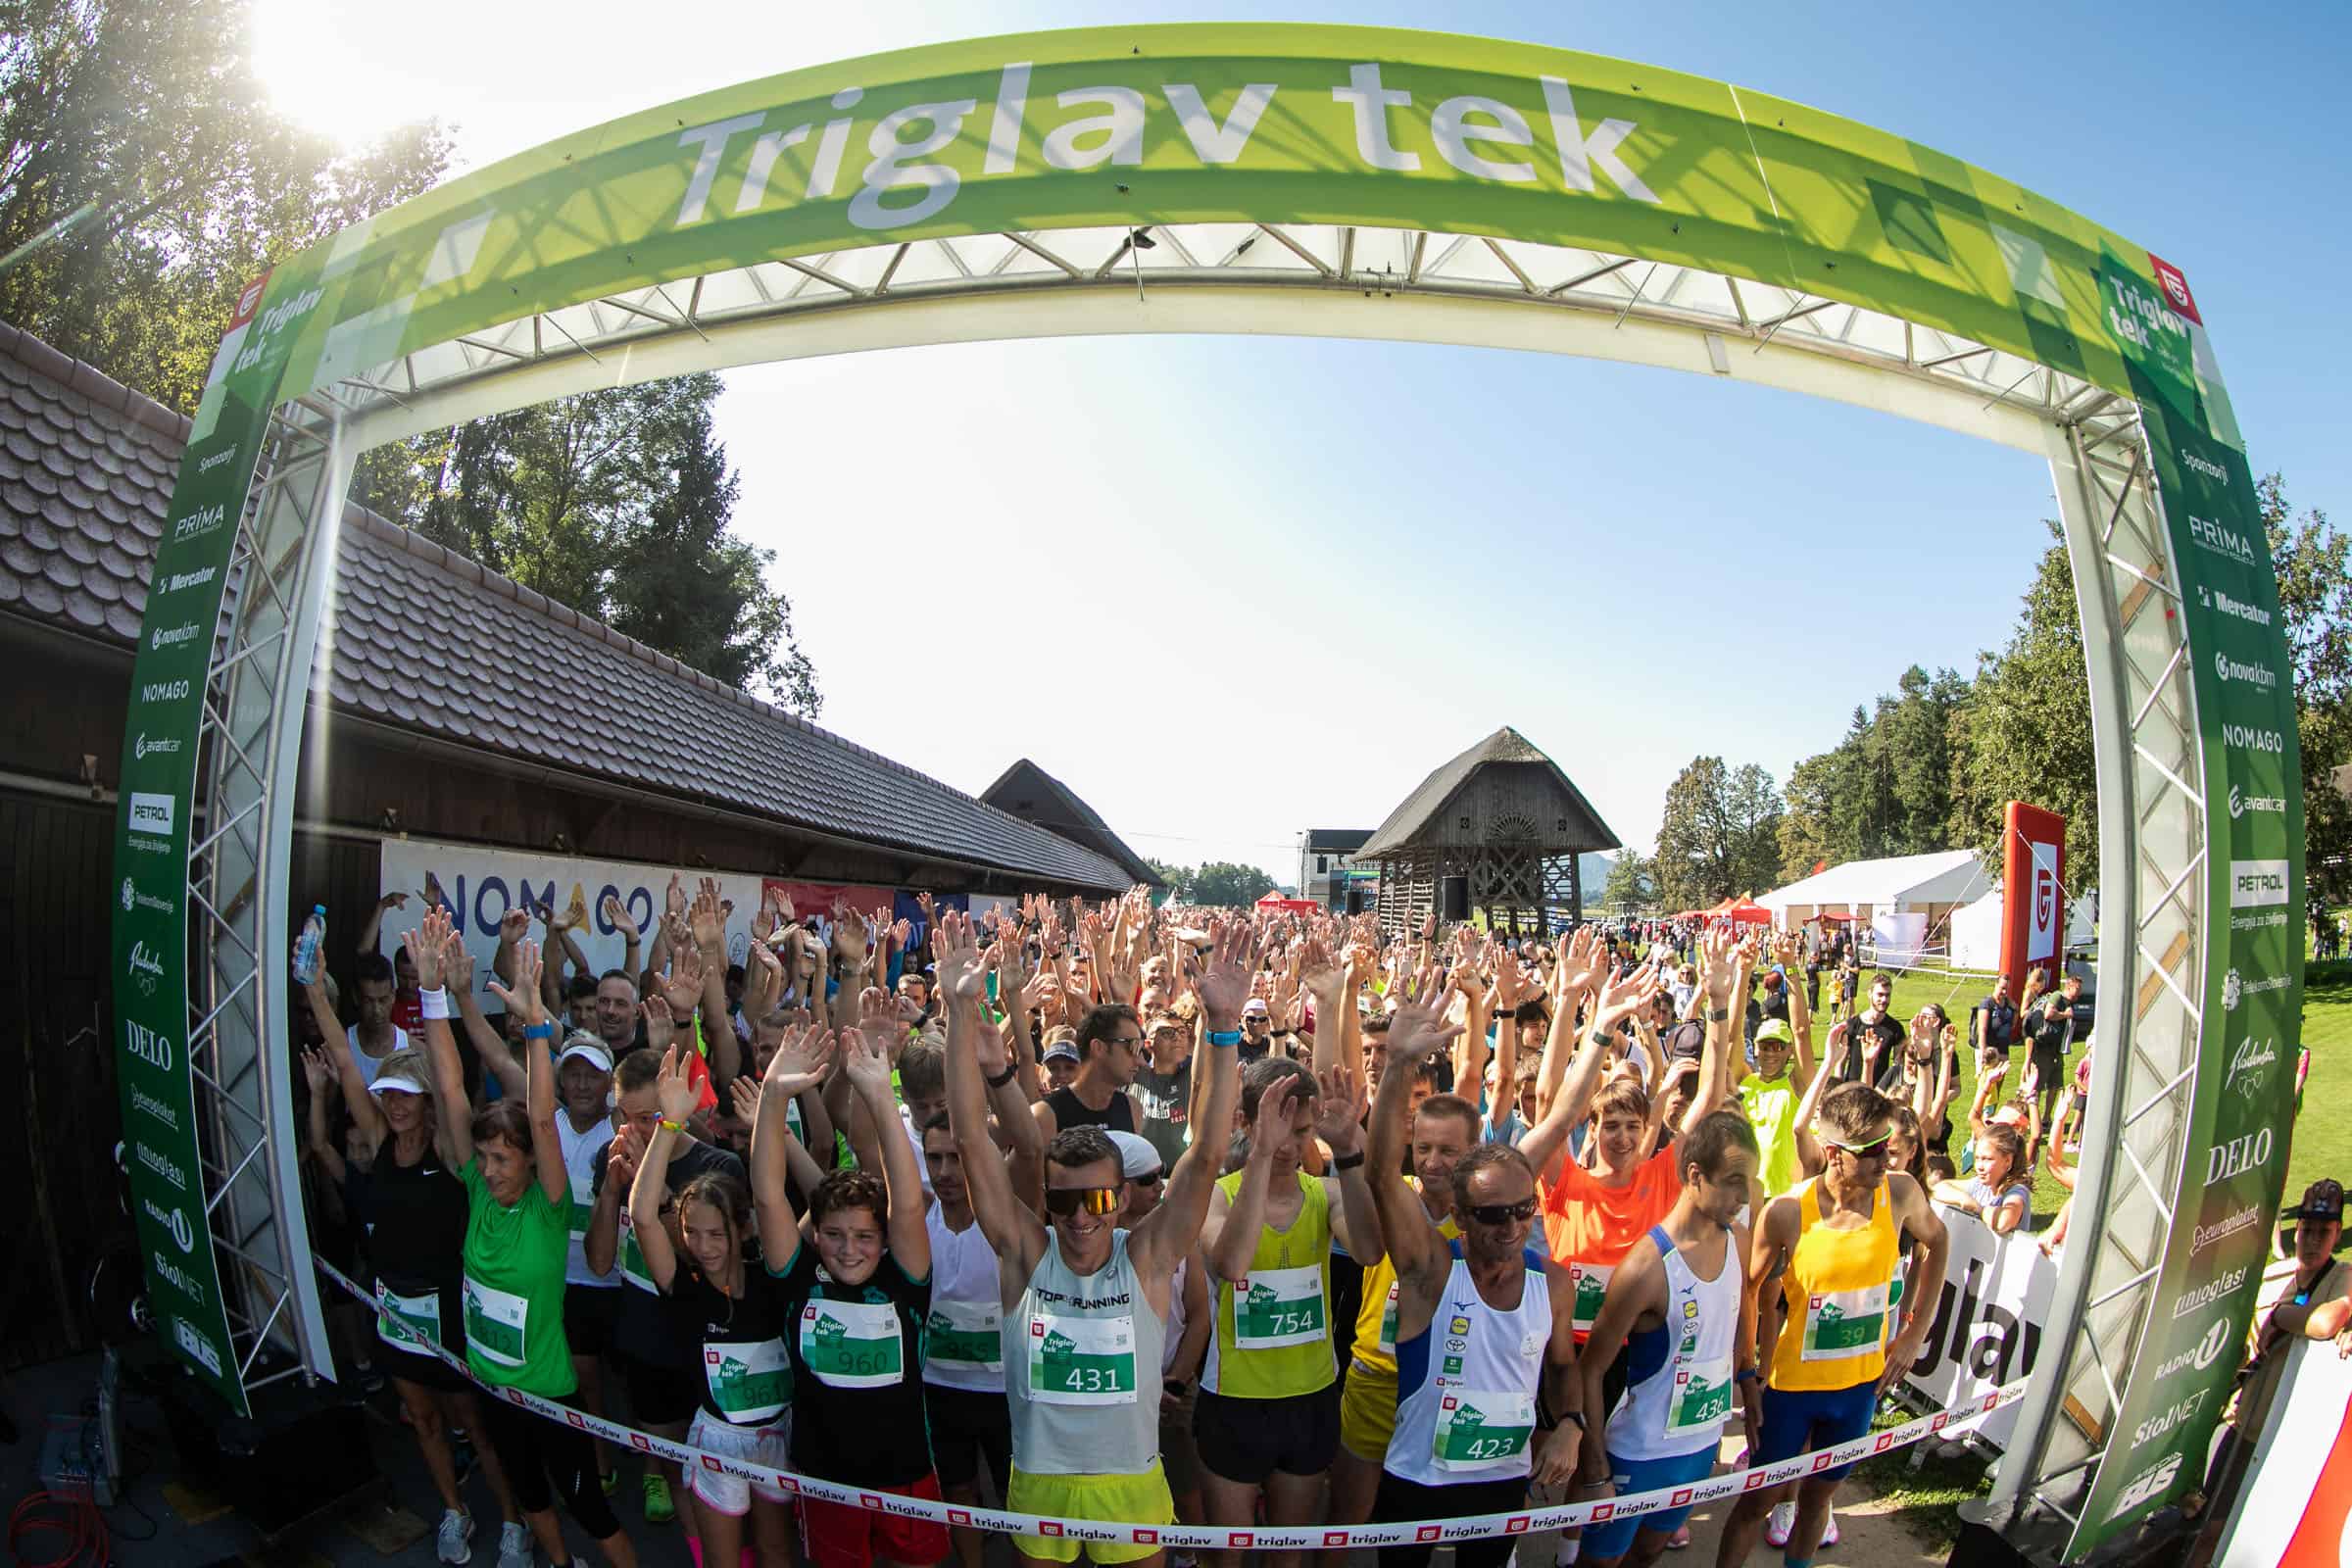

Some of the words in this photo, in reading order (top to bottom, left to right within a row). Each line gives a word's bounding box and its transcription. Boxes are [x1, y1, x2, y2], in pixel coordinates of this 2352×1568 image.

[675, 62, 1278, 230] Triglav
[1332, 62, 1663, 205] tek
[259, 288, 325, 336] Triglav
[2109, 275, 2187, 338] Triglav
[2109, 306, 2152, 350] tek
[233, 334, 267, 374] tek
[2181, 448, 2229, 486] Sponzorji
[170, 564, 217, 592] Mercator
[2215, 591, 2271, 626] Mercator
[2230, 662, 2276, 688] novakbm
[142, 679, 189, 704] NOMAGO
[2222, 722, 2282, 754] NOMAGO
[134, 805, 170, 821] PETROL
[2244, 795, 2286, 812] avantcar
[2238, 874, 2283, 893] PETROL
[126, 1019, 172, 1072] DELO
[2203, 1127, 2273, 1187] DELO
[145, 1199, 172, 1229] RADIO
[1036, 1288, 1064, 1302] TOP
[1073, 1293, 1130, 1310] RUNNING
[820, 1320, 847, 1333] Triglav
[1269, 1310, 1313, 1335] 754
[838, 1350, 887, 1373] 960
[2154, 1348, 2196, 1381] RADIO
[1065, 1367, 1122, 1392] 431
[1694, 1393, 1726, 1421] 436
[1948, 1405, 1977, 1423] triglav
[1892, 1426, 1925, 1445] triglav
[1466, 1437, 1514, 1459] 423
[1833, 1446, 1867, 1464] triglav
[723, 1464, 765, 1483] triglav
[1766, 1465, 1804, 1483] triglav
[802, 1484, 847, 1502] triglav
[1693, 1484, 1734, 1500] triglav
[886, 1501, 933, 1519] triglav
[1616, 1499, 1659, 1516] triglav
[974, 1518, 1023, 1532] triglav
[1444, 1525, 1493, 1539] triglav
[1532, 1514, 1579, 1529] triglav
[1066, 1527, 1117, 1541] triglav
[1160, 1535, 1211, 1545] triglav
[1256, 1537, 1307, 1546] triglav
[1351, 1533, 1401, 1544] triglav
